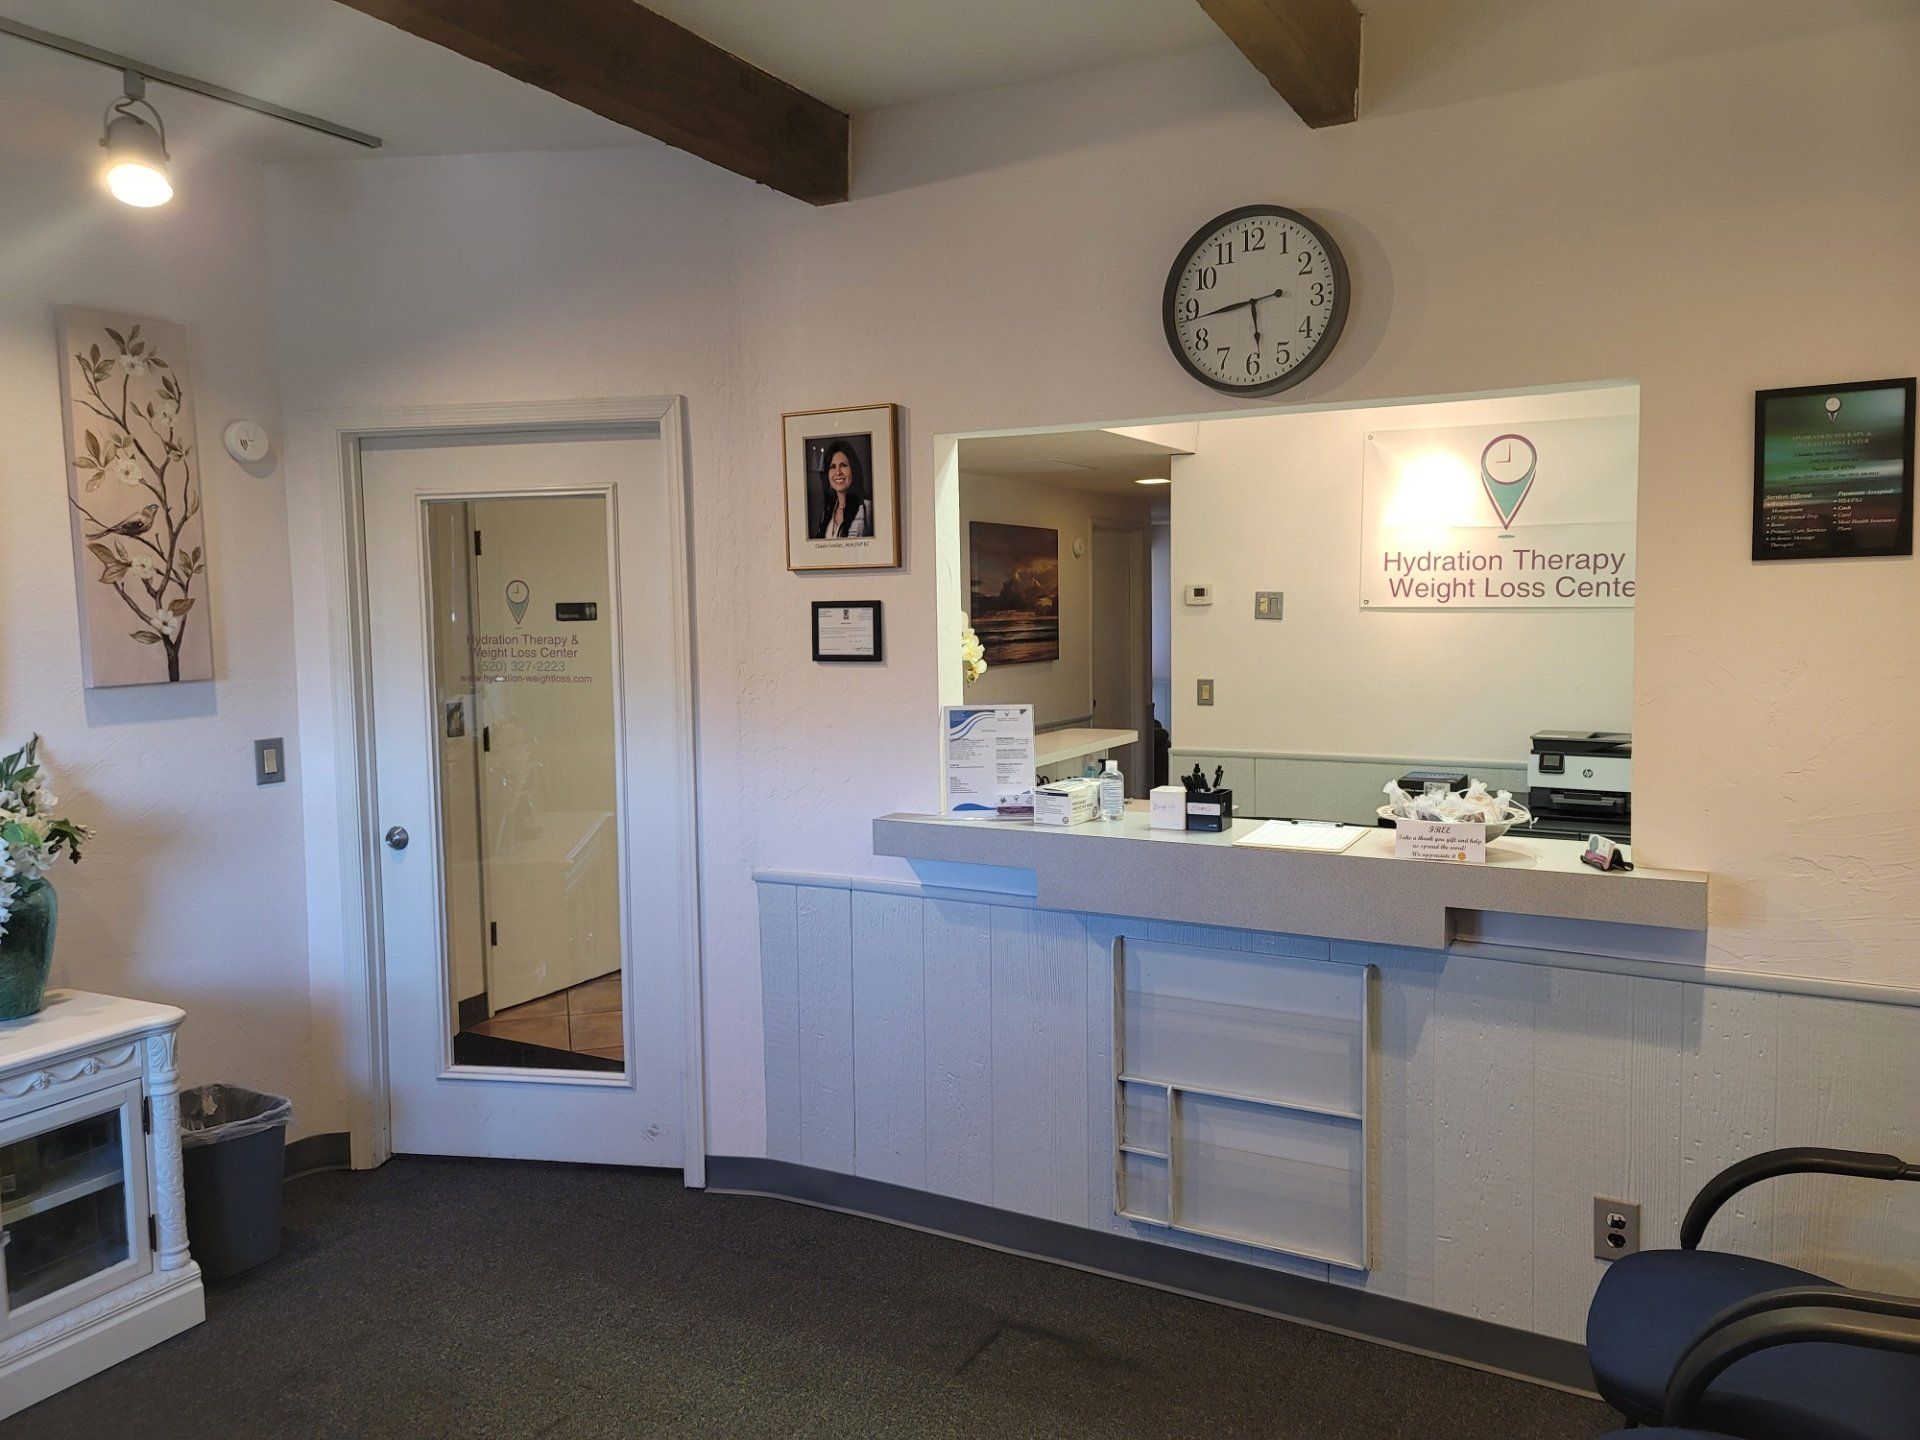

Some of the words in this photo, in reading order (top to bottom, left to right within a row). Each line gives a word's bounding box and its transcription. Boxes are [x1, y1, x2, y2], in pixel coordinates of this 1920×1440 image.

[1242, 228, 1265, 252] 12
[1280, 232, 1288, 254] 1
[1215, 242, 1234, 266] 11
[1298, 252, 1312, 276] 2
[1196, 267, 1216, 290] 10
[1310, 282, 1324, 306] 3
[1186, 298, 1200, 320] 9
[1298, 316, 1312, 338] 4
[1195, 328, 1209, 350] 8
[1216, 346, 1230, 370] 7
[1246, 352, 1260, 375] 6
[1276, 340, 1290, 364] 5
[1384, 550, 1502, 576] Hydration
[1513, 549, 1626, 575] Therapy
[1389, 577, 1475, 603] Weight
[1485, 579, 1545, 598] Loss
[466, 634, 518, 648] Hydration
[521, 634, 567, 647] Therapy
[571, 634, 579, 645] &
[471, 647, 508, 660] Weight
[512, 648, 537, 657] Loss
[540, 648, 578, 658] Center
[478, 661, 506, 673] (520)
[511, 661, 565, 672] 327-2223
[1428, 826, 1452, 834] FREE
